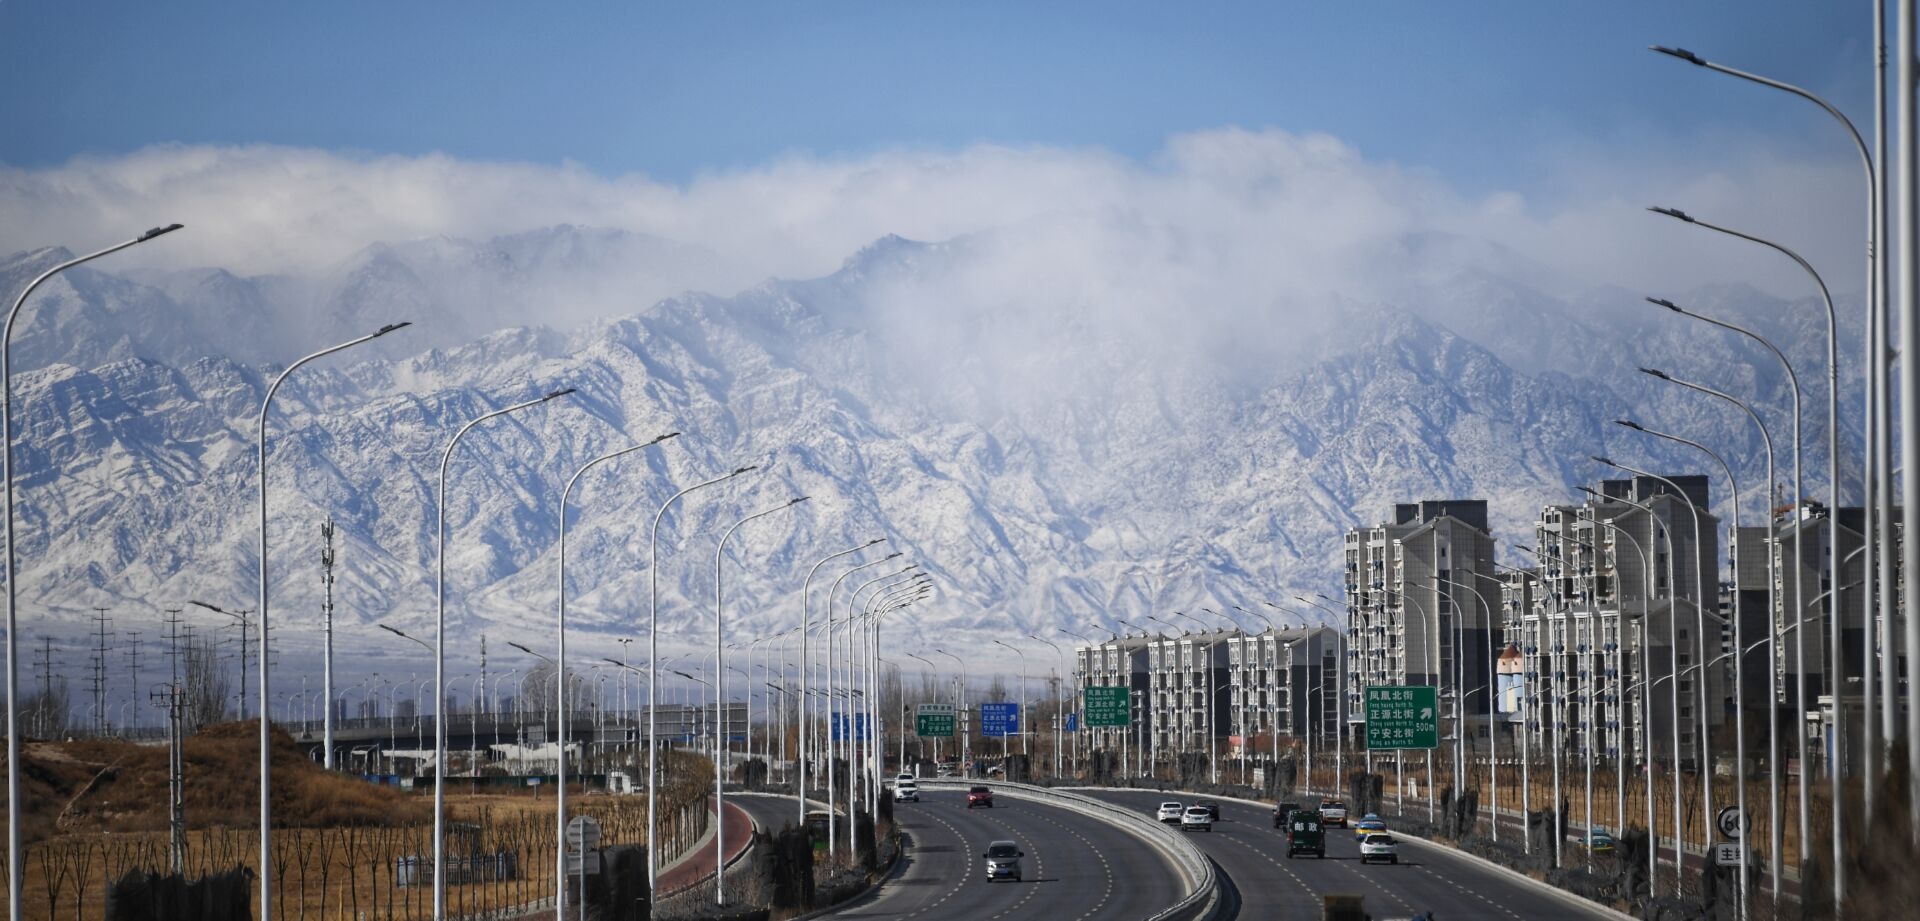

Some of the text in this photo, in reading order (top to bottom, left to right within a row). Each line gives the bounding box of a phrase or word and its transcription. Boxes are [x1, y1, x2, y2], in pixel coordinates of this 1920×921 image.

[1369, 690, 1414, 701] 凤凰北街
[1370, 709, 1414, 720] 正源北街
[1415, 722, 1435, 732] 500m
[1370, 728, 1414, 739] 宁安北街
[1294, 821, 1318, 832] 邮政
